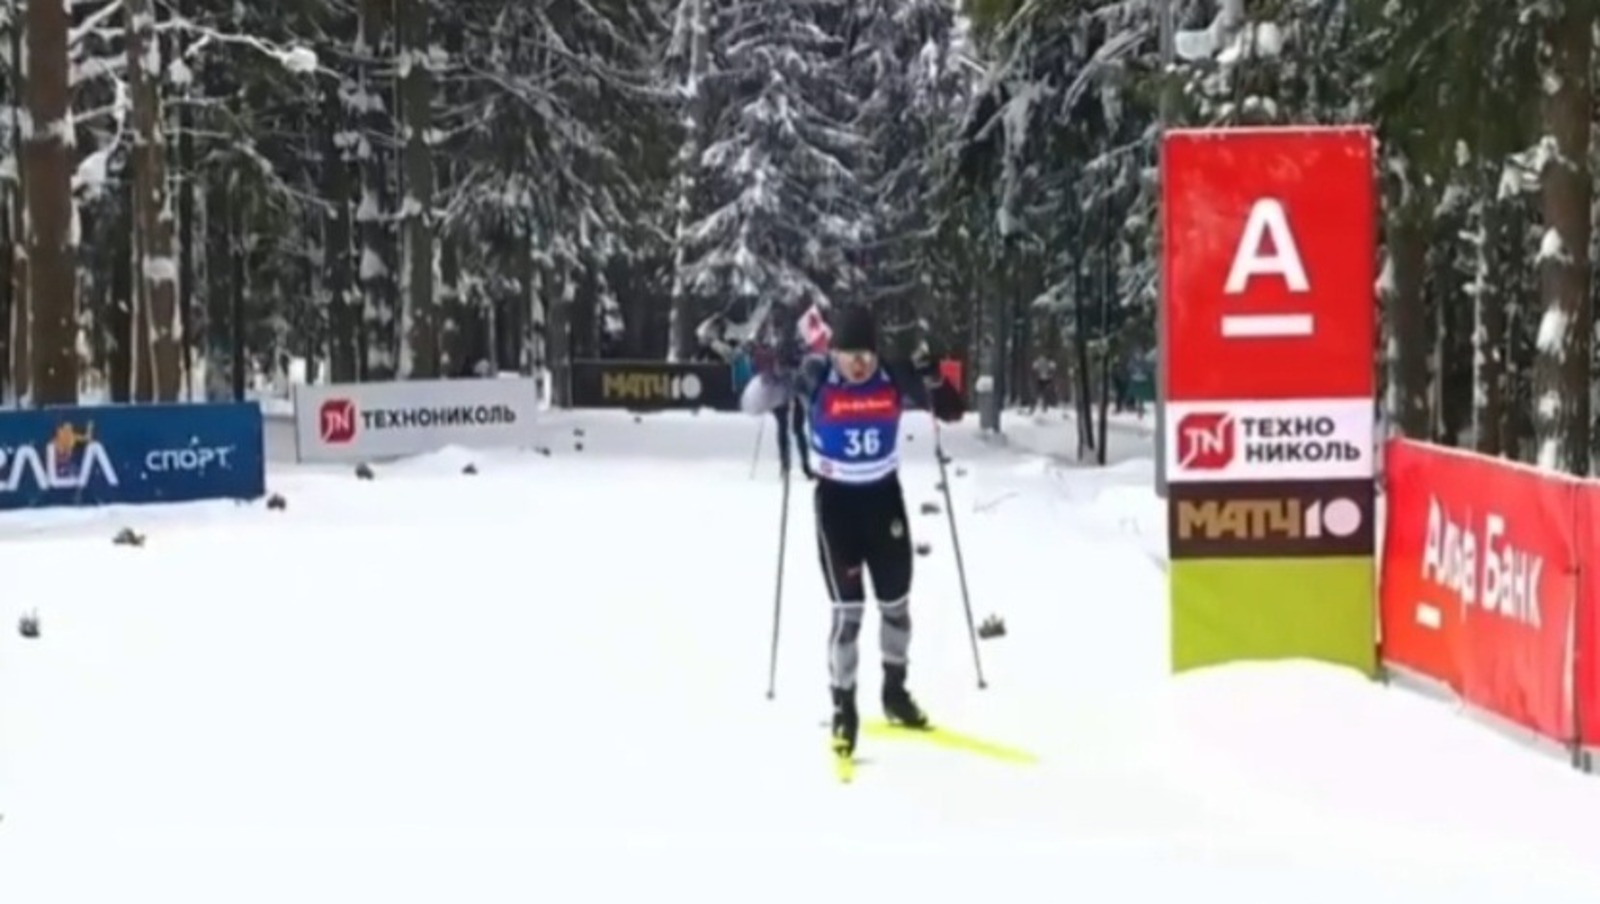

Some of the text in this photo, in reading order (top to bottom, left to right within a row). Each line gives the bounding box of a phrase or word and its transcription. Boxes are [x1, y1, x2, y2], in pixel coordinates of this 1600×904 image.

[361, 404, 516, 429] ТЕХНОНИКОЛЬ
[1241, 417, 1335, 438] ТЕХНО
[844, 428, 881, 457] 36
[1245, 442, 1361, 463] НИКОЛЬ
[0, 442, 118, 490] ALA
[1422, 494, 1543, 630] Альа Банк
